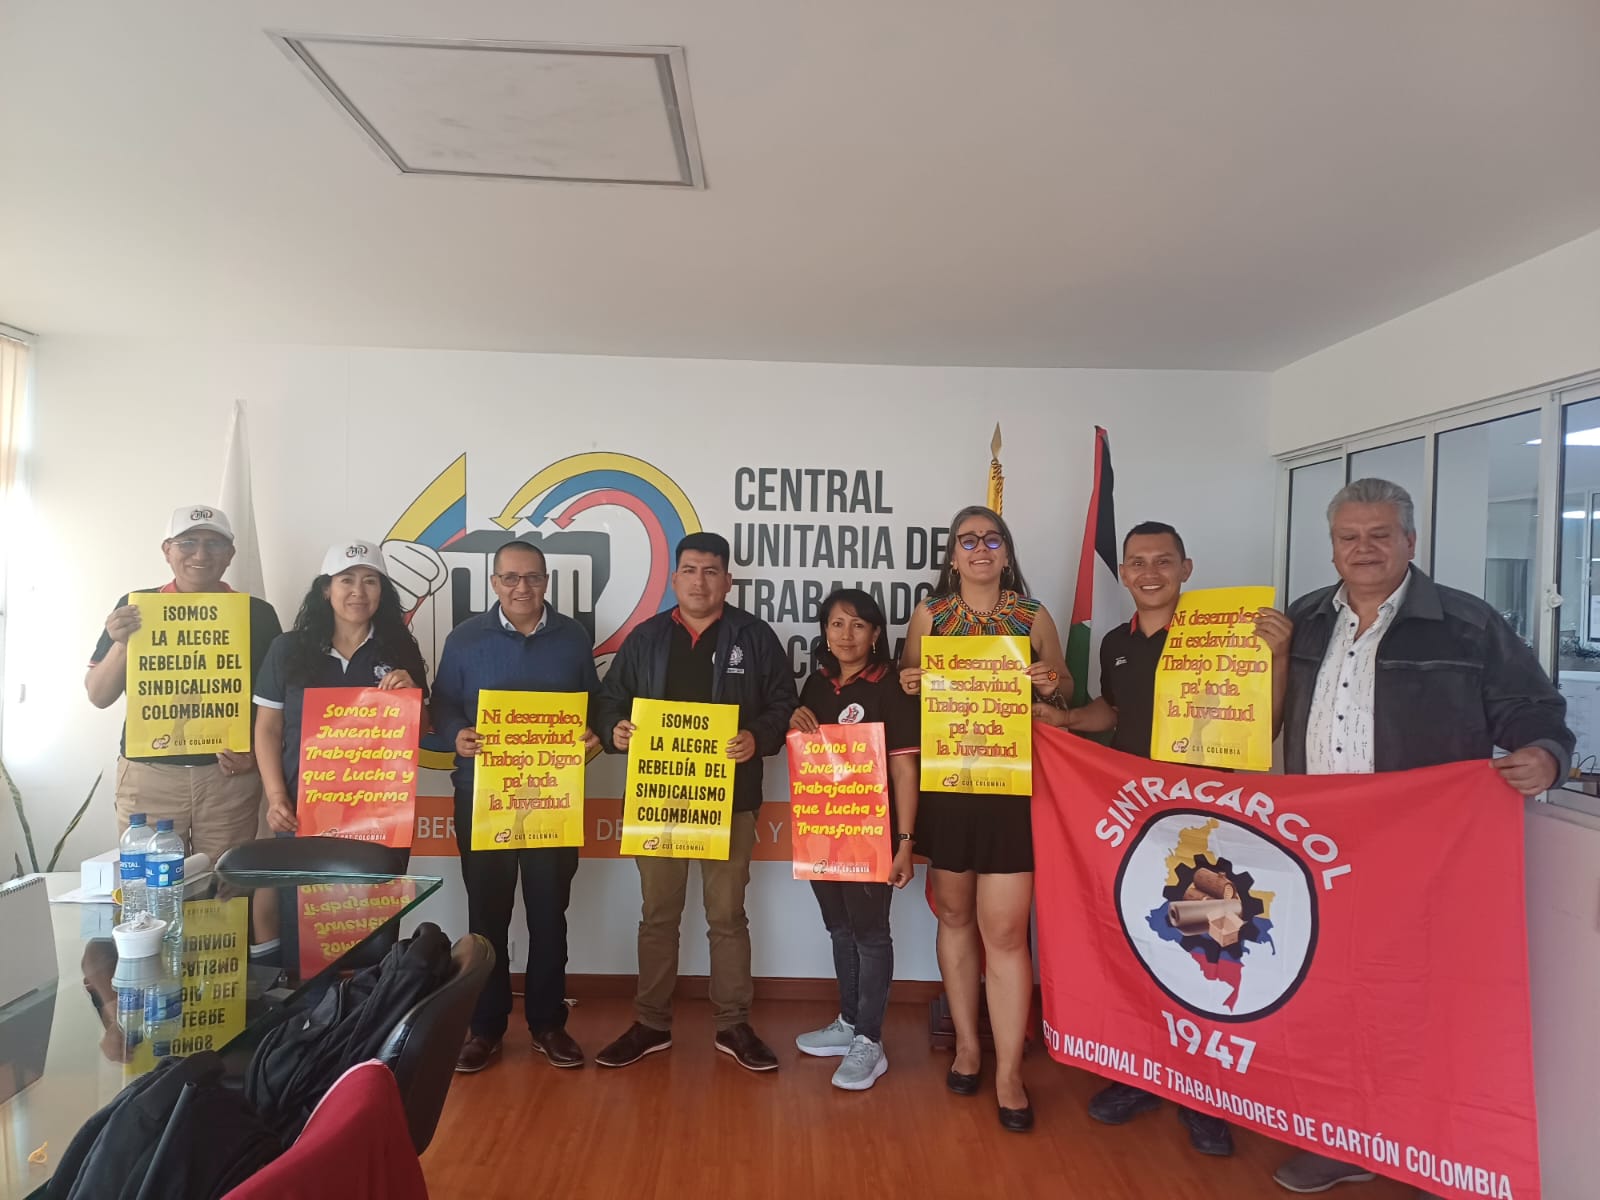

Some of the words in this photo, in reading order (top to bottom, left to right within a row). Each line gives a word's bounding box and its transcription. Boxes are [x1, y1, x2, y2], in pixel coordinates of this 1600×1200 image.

[735, 467, 892, 514] CENTRAL
[734, 523, 894, 569] UNITARIA
[906, 526, 949, 570] DE
[164, 606, 217, 621] ¡SOMOS
[1172, 610, 1185, 626] Ni
[152, 630, 168, 646] LA
[177, 630, 230, 645] ALEGRE
[1169, 633, 1183, 648] ni
[1186, 631, 1261, 652] esclavitud,
[139, 650, 206, 671] REBELDÍA
[217, 654, 242, 670] DEL
[925, 655, 945, 670] Ni
[1162, 655, 1212, 675] Trabajo
[1216, 655, 1268, 676] Digno
[138, 678, 242, 695] SINDICALISMO
[931, 676, 946, 691] ni
[950, 676, 1021, 695] esclavitud,
[1205, 679, 1240, 696] toda
[142, 703, 239, 720] COLOMBIANO!
[323, 704, 377, 718] Somos
[383, 705, 400, 718] la
[925, 698, 978, 716] Trabajo
[983, 698, 1028, 718] Digno
[1168, 701, 1181, 718] la
[1184, 702, 1255, 721] Juventud
[482, 710, 501, 724] Ni
[505, 710, 582, 728] desempleo,
[662, 714, 709, 730] ¡SOMOS
[974, 720, 1004, 735] toda
[316, 726, 406, 739] Juventud
[486, 730, 500, 745] ni
[505, 730, 576, 747] esclavitud,
[651, 736, 664, 751] LA
[672, 738, 718, 754] ALEGRE
[803, 741, 846, 754] Somos
[852, 741, 866, 753] la
[936, 740, 950, 755] la
[953, 741, 1017, 758] Juventud
[1207, 746, 1240, 755] COLOMBIA
[305, 746, 413, 763] Trabajadora
[481, 751, 534, 769] Trabajo
[537, 750, 582, 769] Digno
[638, 758, 696, 776] REBELDÍA
[705, 763, 727, 778] DEL
[800, 760, 873, 774] Juventud
[302, 770, 336, 785] que
[343, 768, 396, 782] Lucha
[402, 771, 414, 784] y
[528, 772, 558, 788] toda
[636, 783, 726, 801] SINDICALISMO
[793, 781, 883, 797] Trabajadora
[305, 790, 409, 806] Transforma
[490, 795, 503, 810] la
[506, 793, 570, 810] Juventud
[638, 807, 722, 825] COLOMBIANO!
[793, 804, 819, 818] que
[825, 802, 869, 815] Lucha
[876, 805, 886, 817] y
[768, 822, 783, 842] Y
[797, 822, 883, 838] Transforma
[1096, 777, 1351, 890] SINTRACARCOL
[1161, 1010, 1256, 1074] 1947
[1064, 1035, 1139, 1076] NACIONAL
[1144, 1058, 1162, 1085] DE
[1165, 1067, 1288, 1132] TRABAJADORES
[1293, 1113, 1318, 1141] DE
[1322, 1122, 1400, 1167] CARTÓN
[1406, 1146, 1513, 1200] COLOMBIA
